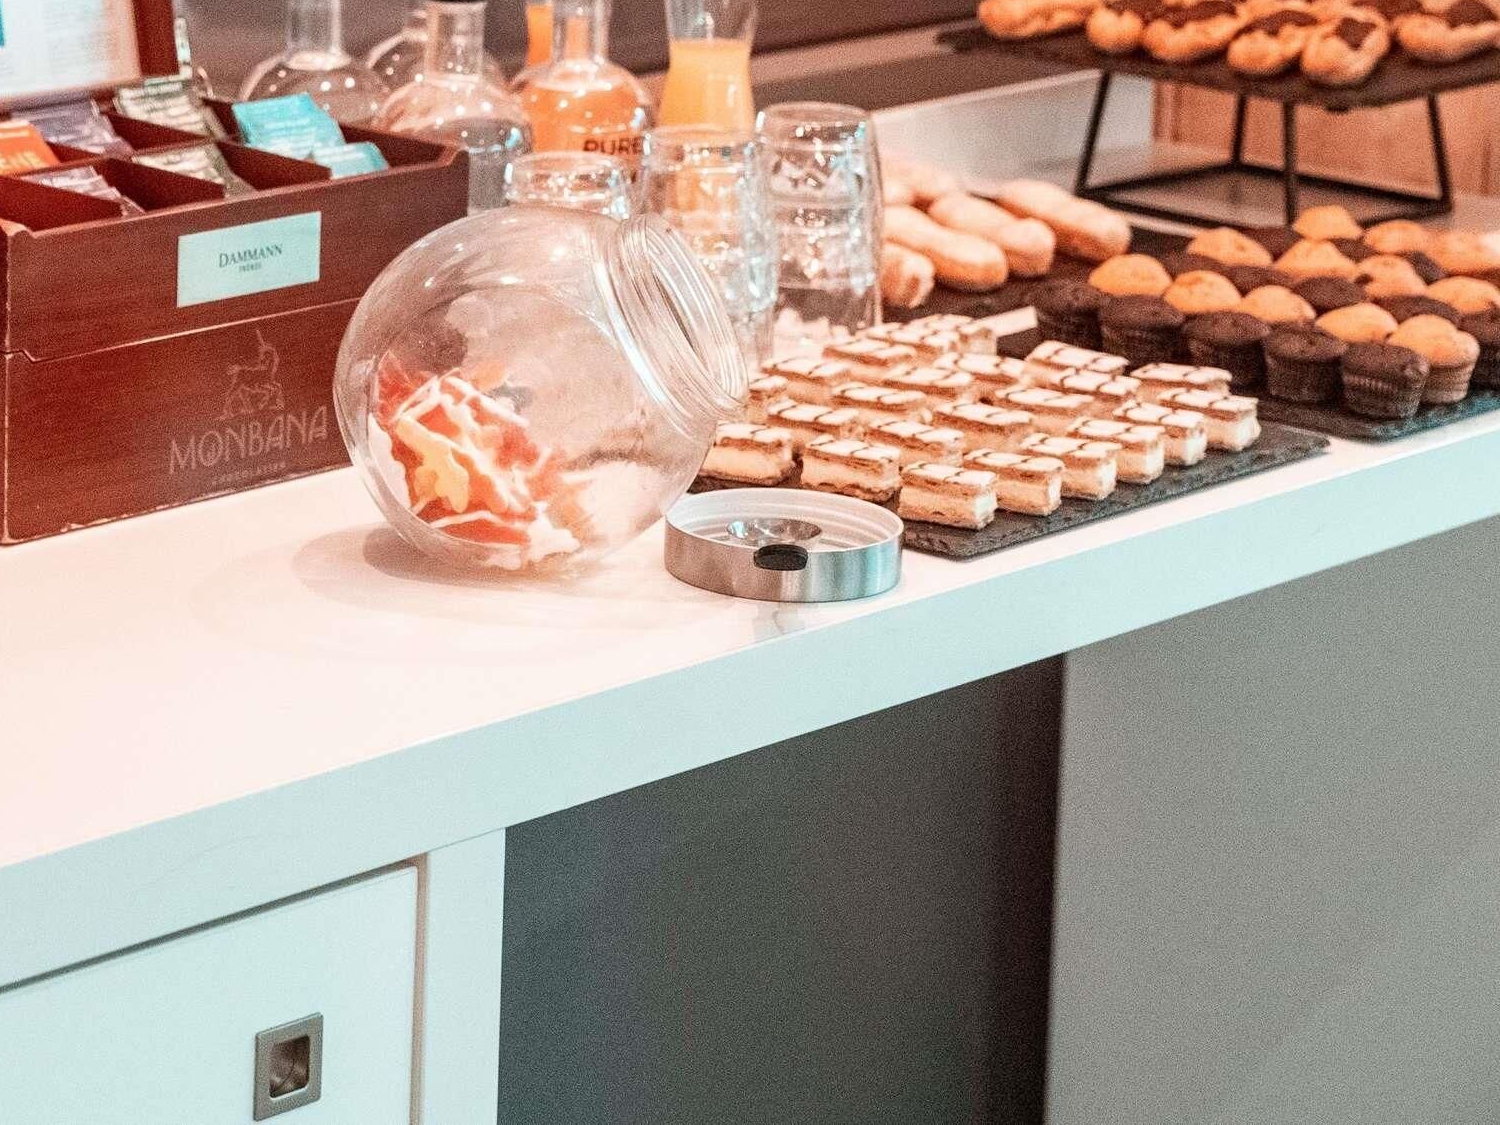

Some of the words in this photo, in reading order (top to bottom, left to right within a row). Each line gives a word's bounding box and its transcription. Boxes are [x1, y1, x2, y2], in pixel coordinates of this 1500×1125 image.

[582, 135, 645, 156] PURE
[218, 243, 284, 269] DAMMANN
[169, 405, 328, 475] MONBANA
